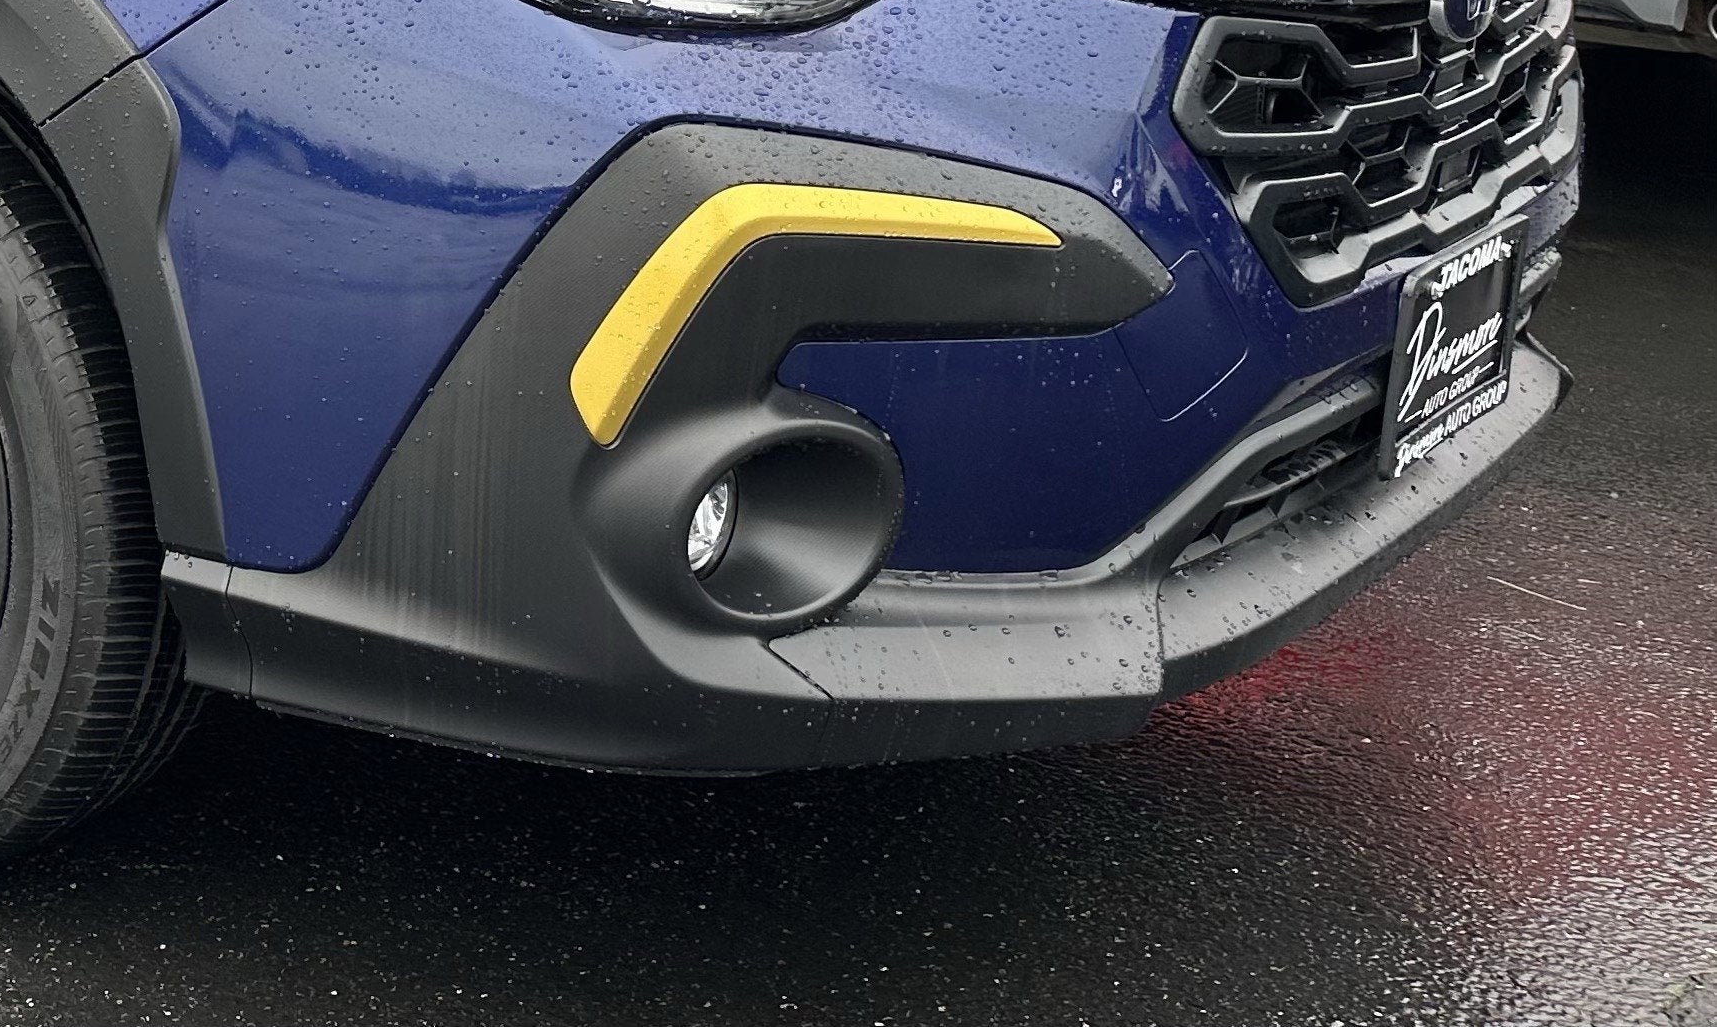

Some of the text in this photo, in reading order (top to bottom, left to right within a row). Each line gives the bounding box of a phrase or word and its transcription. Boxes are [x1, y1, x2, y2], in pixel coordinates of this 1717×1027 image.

[1440, 235, 1503, 291] TACOMA
[1397, 301, 1503, 423] Dinsmore
[1421, 365, 1481, 419] AUTO GROUP
[1443, 402, 1472, 437] AUTO
[1472, 380, 1508, 418] GROUP
